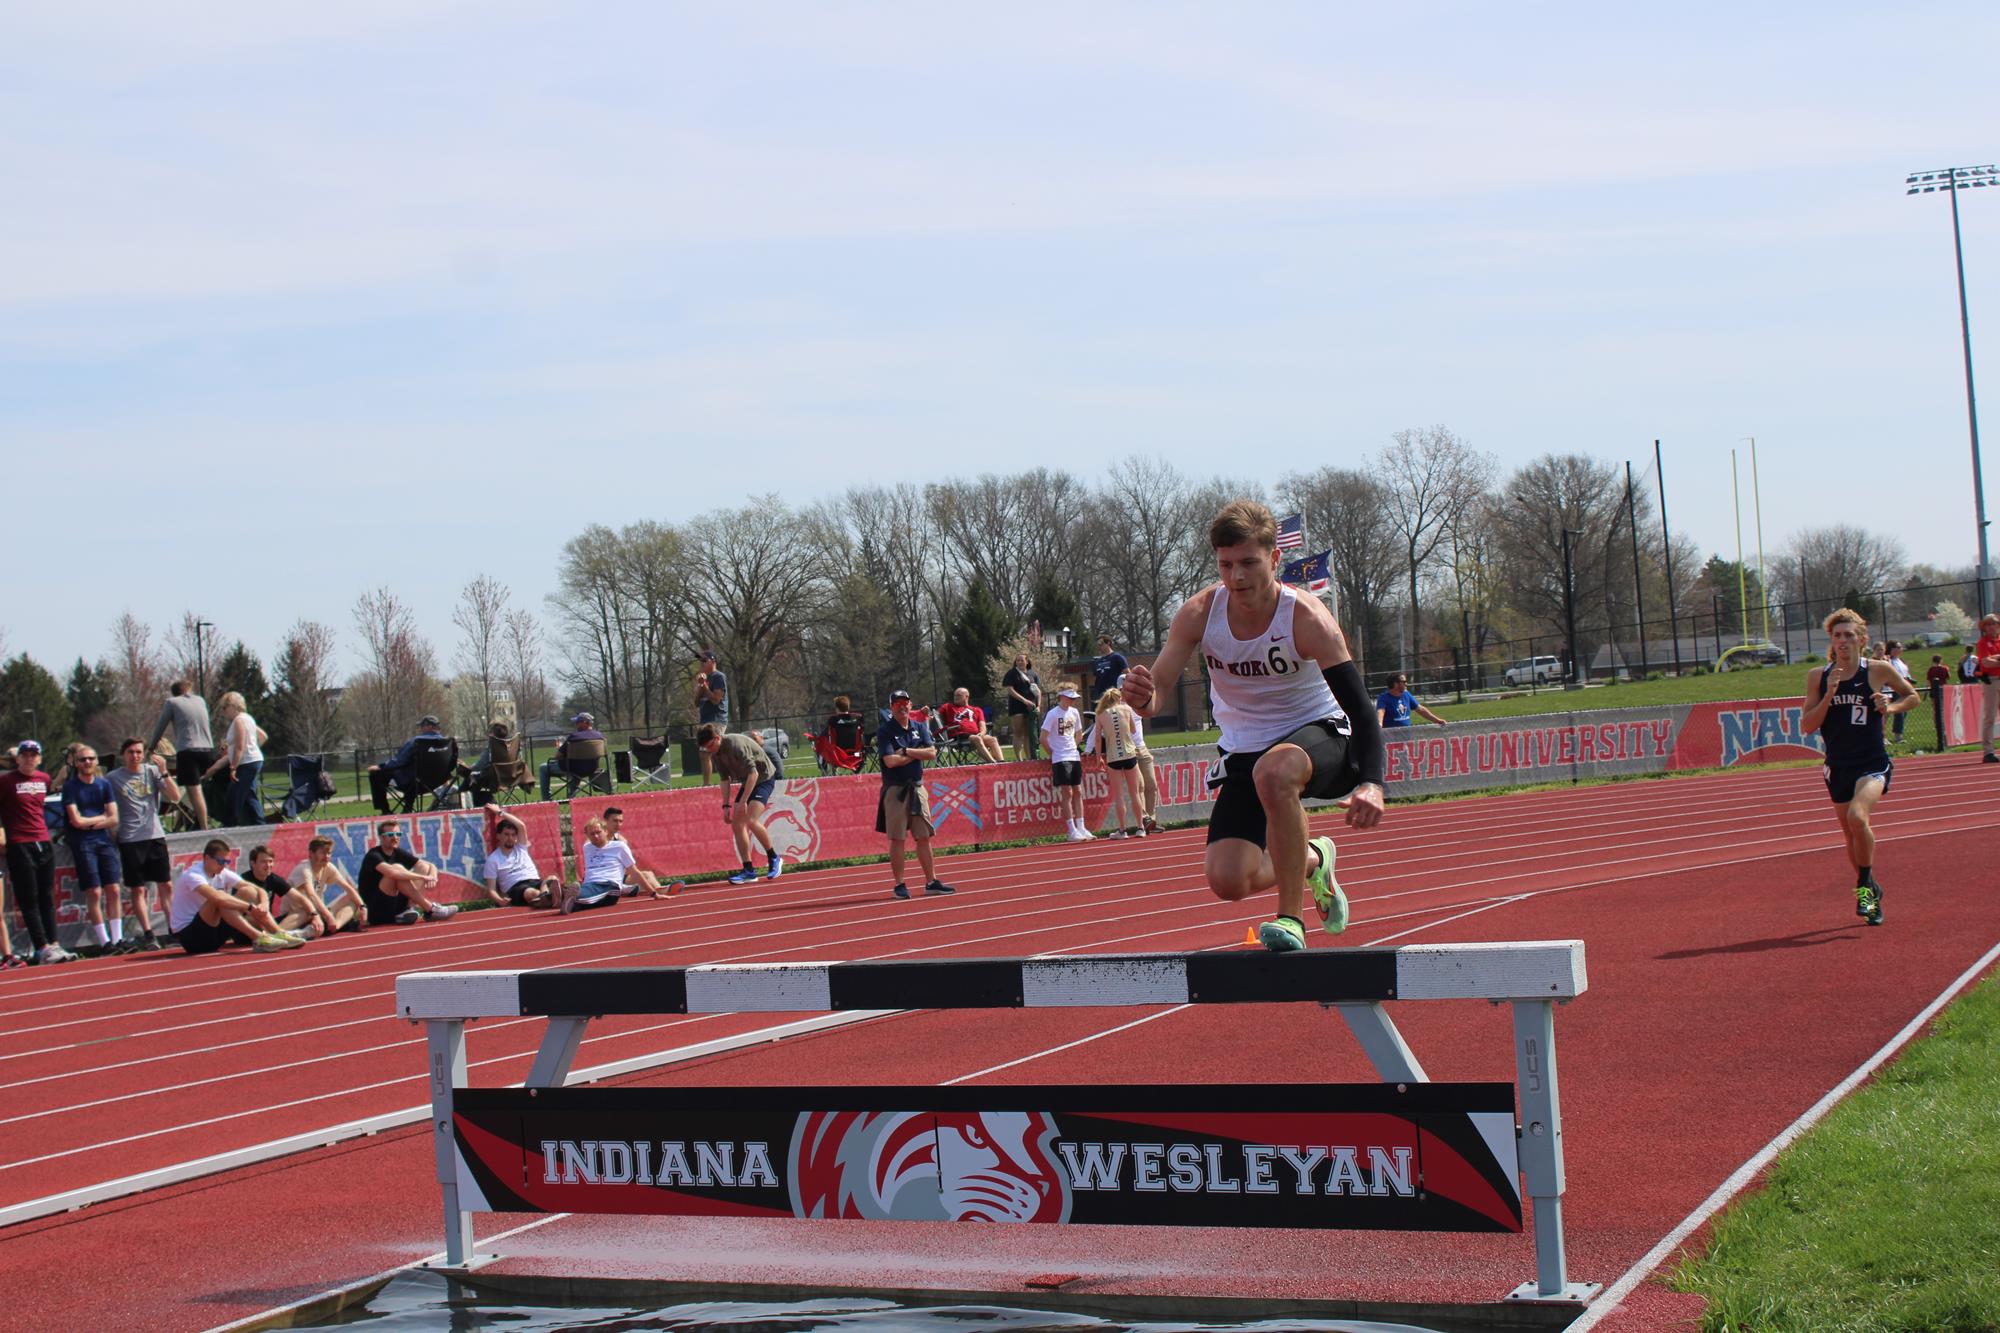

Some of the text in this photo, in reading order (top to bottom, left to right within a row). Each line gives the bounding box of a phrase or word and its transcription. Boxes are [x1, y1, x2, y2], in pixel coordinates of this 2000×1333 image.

[1268, 646, 1289, 674] 6
[1829, 694, 1864, 706] RINE
[1855, 707, 1863, 723] 2
[1383, 741, 1471, 783] EYAN
[1477, 720, 1672, 773] UNIVERSITY
[994, 772, 1108, 808] CROSSRDS
[995, 806, 1061, 825] LEAGU
[435, 1052, 445, 1096] UCS
[1525, 1039, 1540, 1092] UCS
[540, 1140, 1415, 1197] INDIANA WESLEYAN
